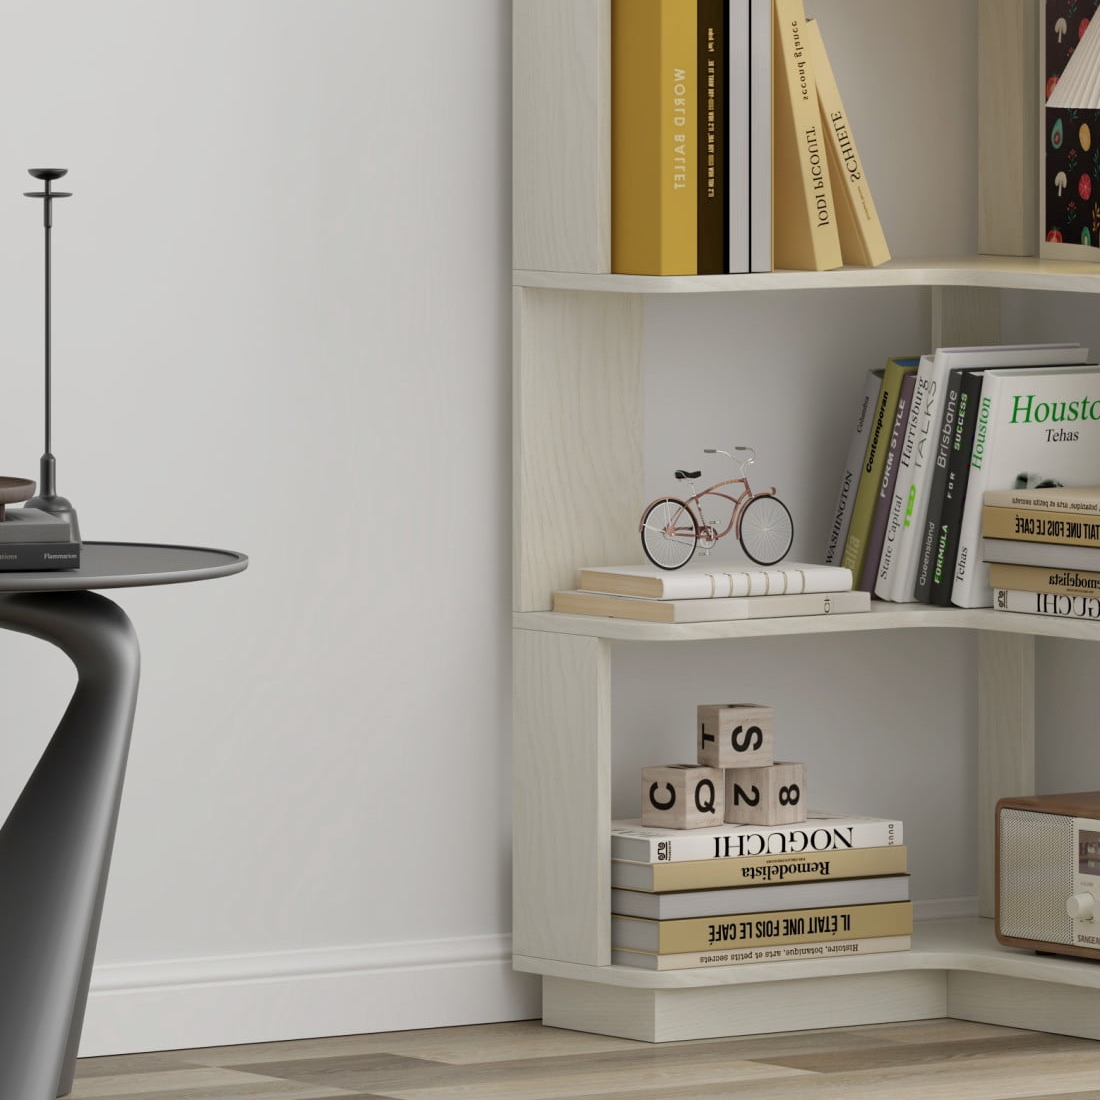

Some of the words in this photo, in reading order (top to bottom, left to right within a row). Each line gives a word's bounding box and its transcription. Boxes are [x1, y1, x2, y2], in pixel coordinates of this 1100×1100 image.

[866, 390, 889, 473] Contemporan
[914, 380, 937, 469] TALKS
[1045, 428, 1080, 443] Tehas
[880, 452, 896, 498] FORM
[890, 399, 906, 450] STYLE
[879, 546, 893, 580] State
[887, 495, 903, 543] Capital
[900, 378, 929, 468] Harrisburg
[919, 521, 935, 586] Queensland
[937, 390, 957, 469] Brisbane
[934, 524, 949, 584] FORMULA
[946, 472, 956, 499] FOR
[953, 392, 968, 451] SUCCESS
[955, 546, 968, 582] Tehas
[971, 397, 992, 471] Houston
[825, 471, 853, 564] WASHINGTON
[701, 723, 716, 750] T
[731, 725, 763, 753] S
[649, 781, 676, 811] C
[694, 778, 716, 815] Q
[733, 783, 760, 807] 2
[778, 783, 800, 806] 8
[712, 827, 854, 858] NOGUCHI
[741, 861, 830, 881] Remodelista
[708, 923, 737, 946] CAFÉ
[740, 922, 752, 940] LE
[755, 920, 780, 939] FOIS
[783, 918, 805, 937] UNE
[807, 915, 838, 936] ÉTAIT
[840, 914, 851, 932] IL
[699, 954, 729, 964] secrets
[730, 951, 753, 962] petits
[754, 951, 763, 960] et
[764, 949, 781, 958] arts
[783, 946, 823, 957] botanique,
[825, 944, 859, 954] Histoire,
